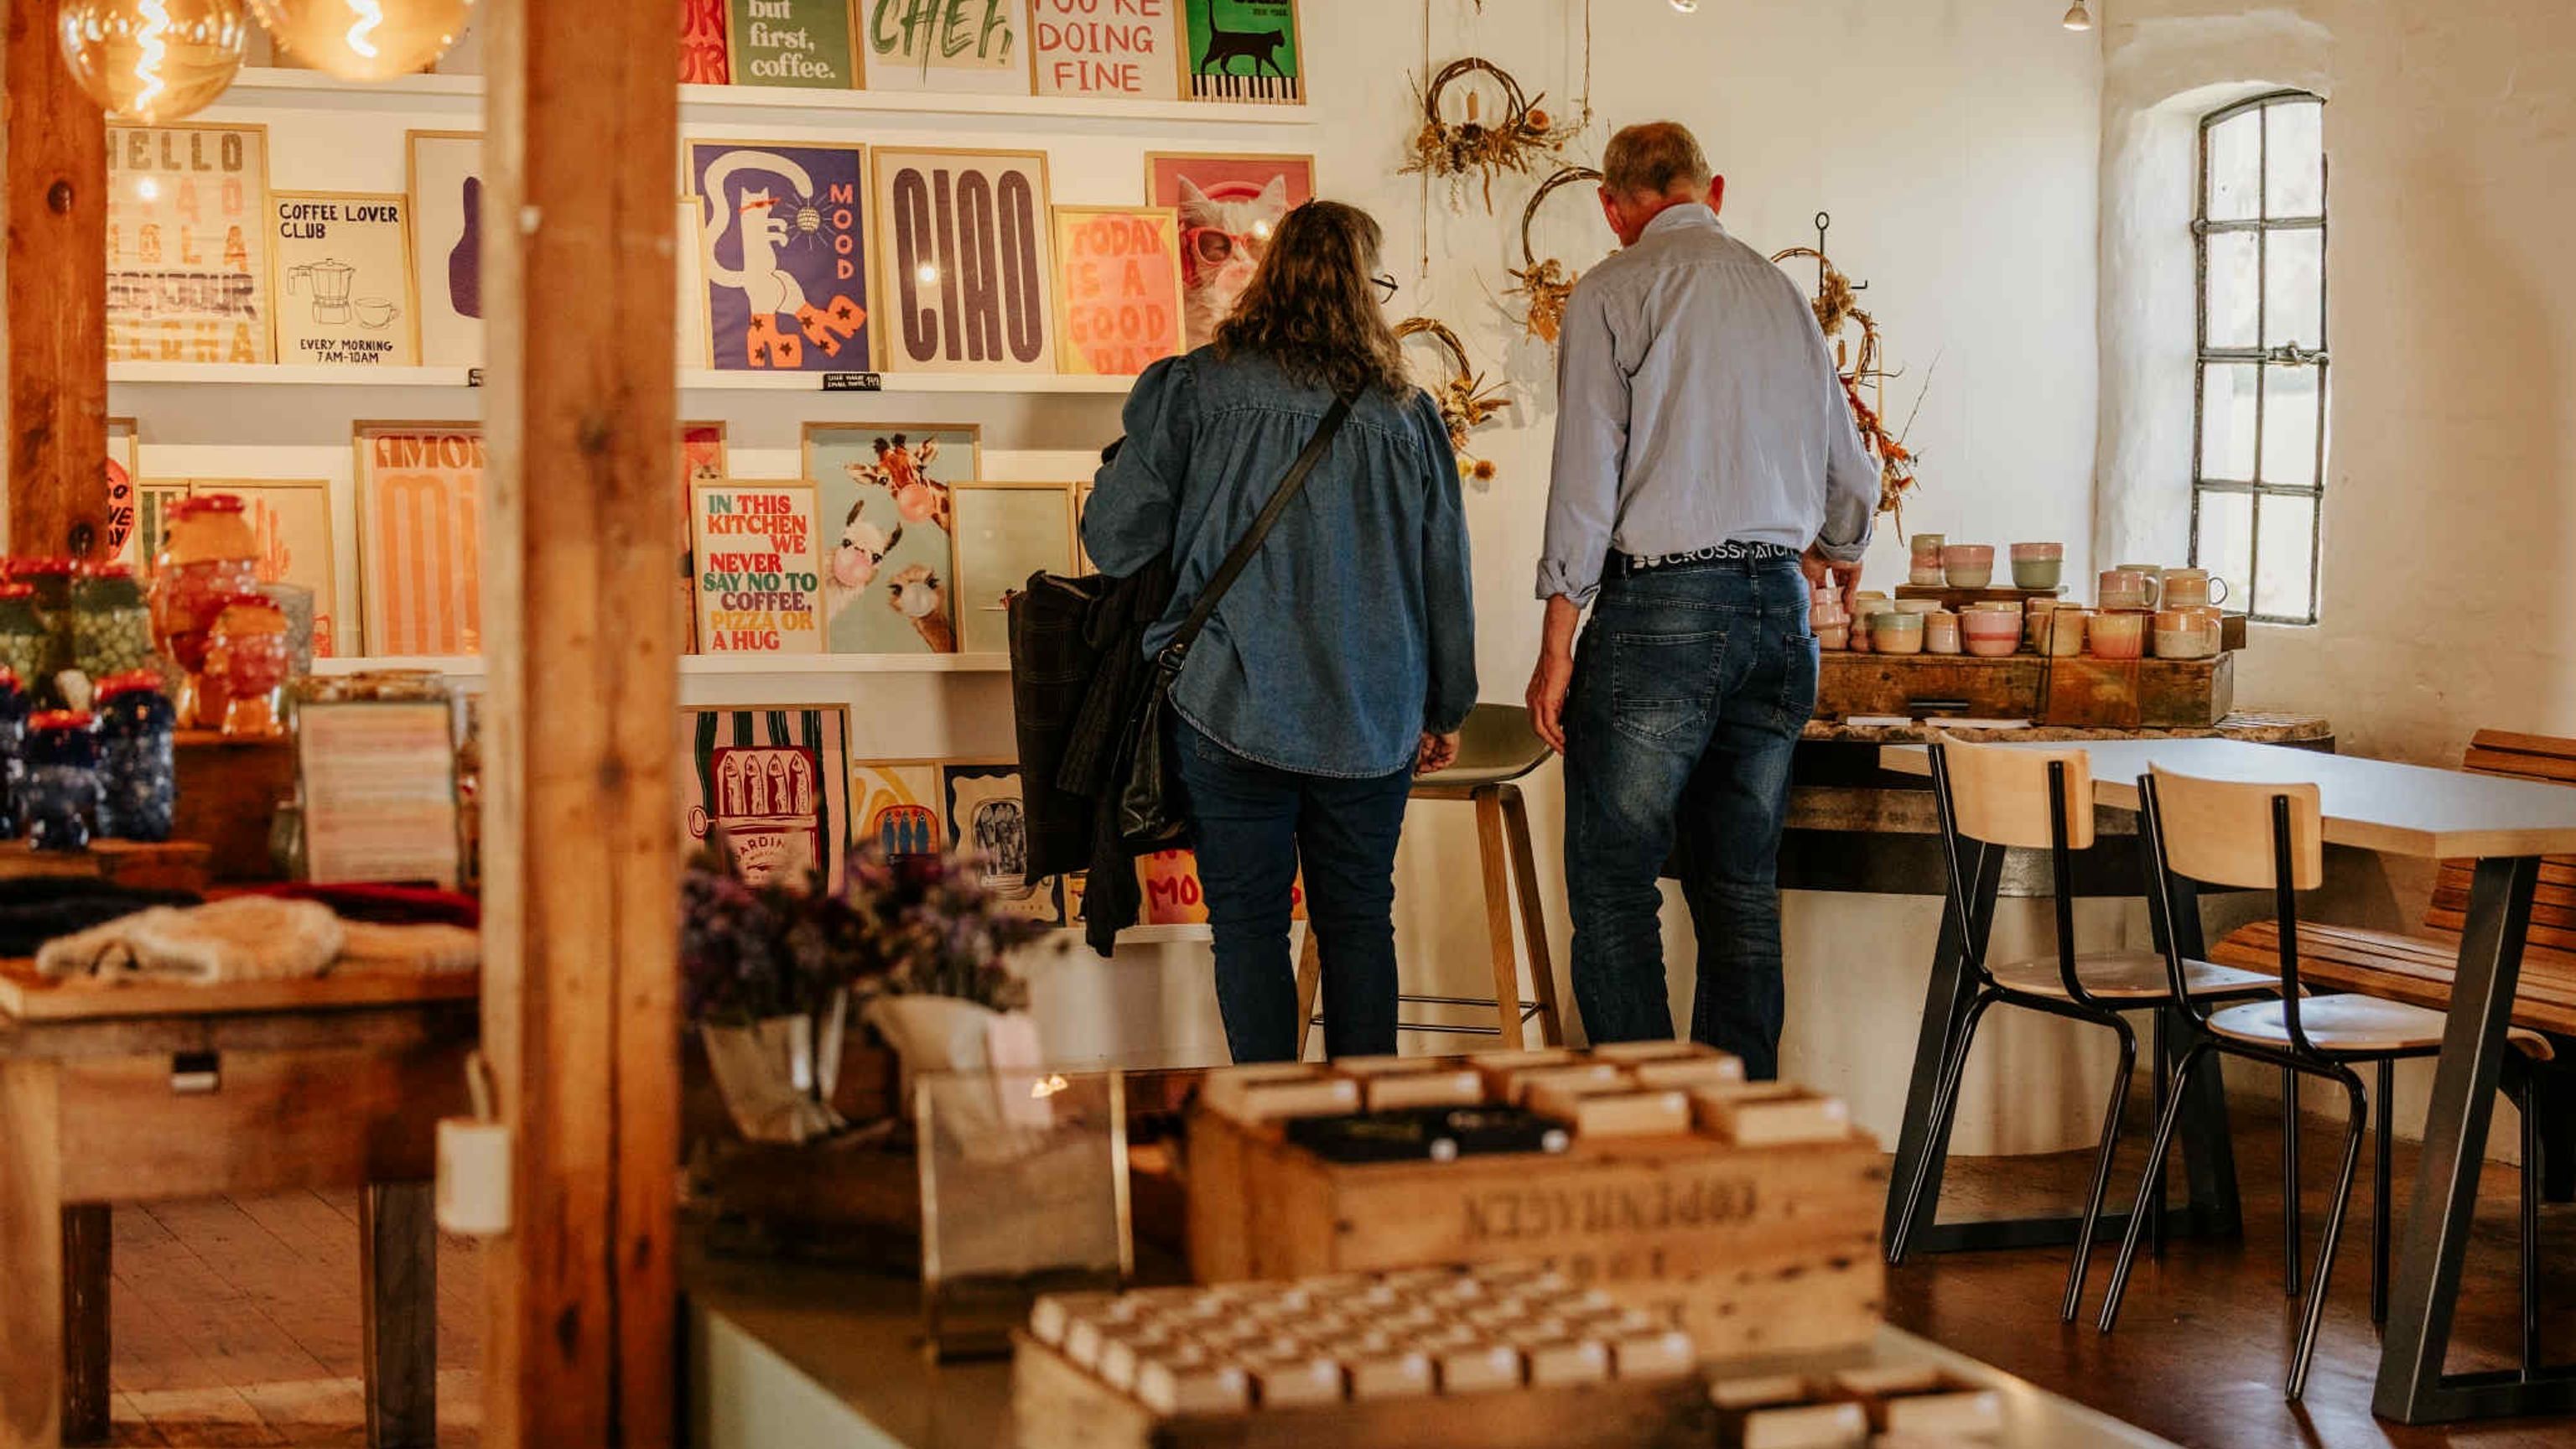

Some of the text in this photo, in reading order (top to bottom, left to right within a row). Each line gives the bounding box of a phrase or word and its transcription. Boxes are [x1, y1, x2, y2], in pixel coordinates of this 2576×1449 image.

[747, 0, 790, 18] but
[1035, 0, 1161, 17] OURE
[749, 22, 814, 52] first,
[1038, 22, 1153, 54] DOING
[750, 52, 836, 78] coffee.
[1053, 60, 1142, 92] FINE
[279, 204, 398, 223] COFFEE LOVER
[280, 222, 326, 239] CLUB
[828, 183, 855, 281] MOOD
[1069, 218, 1166, 256] TODAY
[892, 168, 1043, 363] CIAO
[1066, 259, 1147, 299] IS A
[1071, 304, 1166, 344] GOOD
[300, 338, 393, 351] EVERY MORNING
[317, 351, 379, 363] 7AM-10AM
[708, 495, 792, 515] IN THIS
[707, 514, 808, 535] KITCHEN
[769, 534, 807, 554] WE
[709, 553, 783, 574] NEVER
[703, 572, 818, 592] SAY NO TO
[720, 591, 813, 613] COFFEE,
[711, 610, 816, 631] PIZZA OR
[713, 631, 780, 651] A HUG
